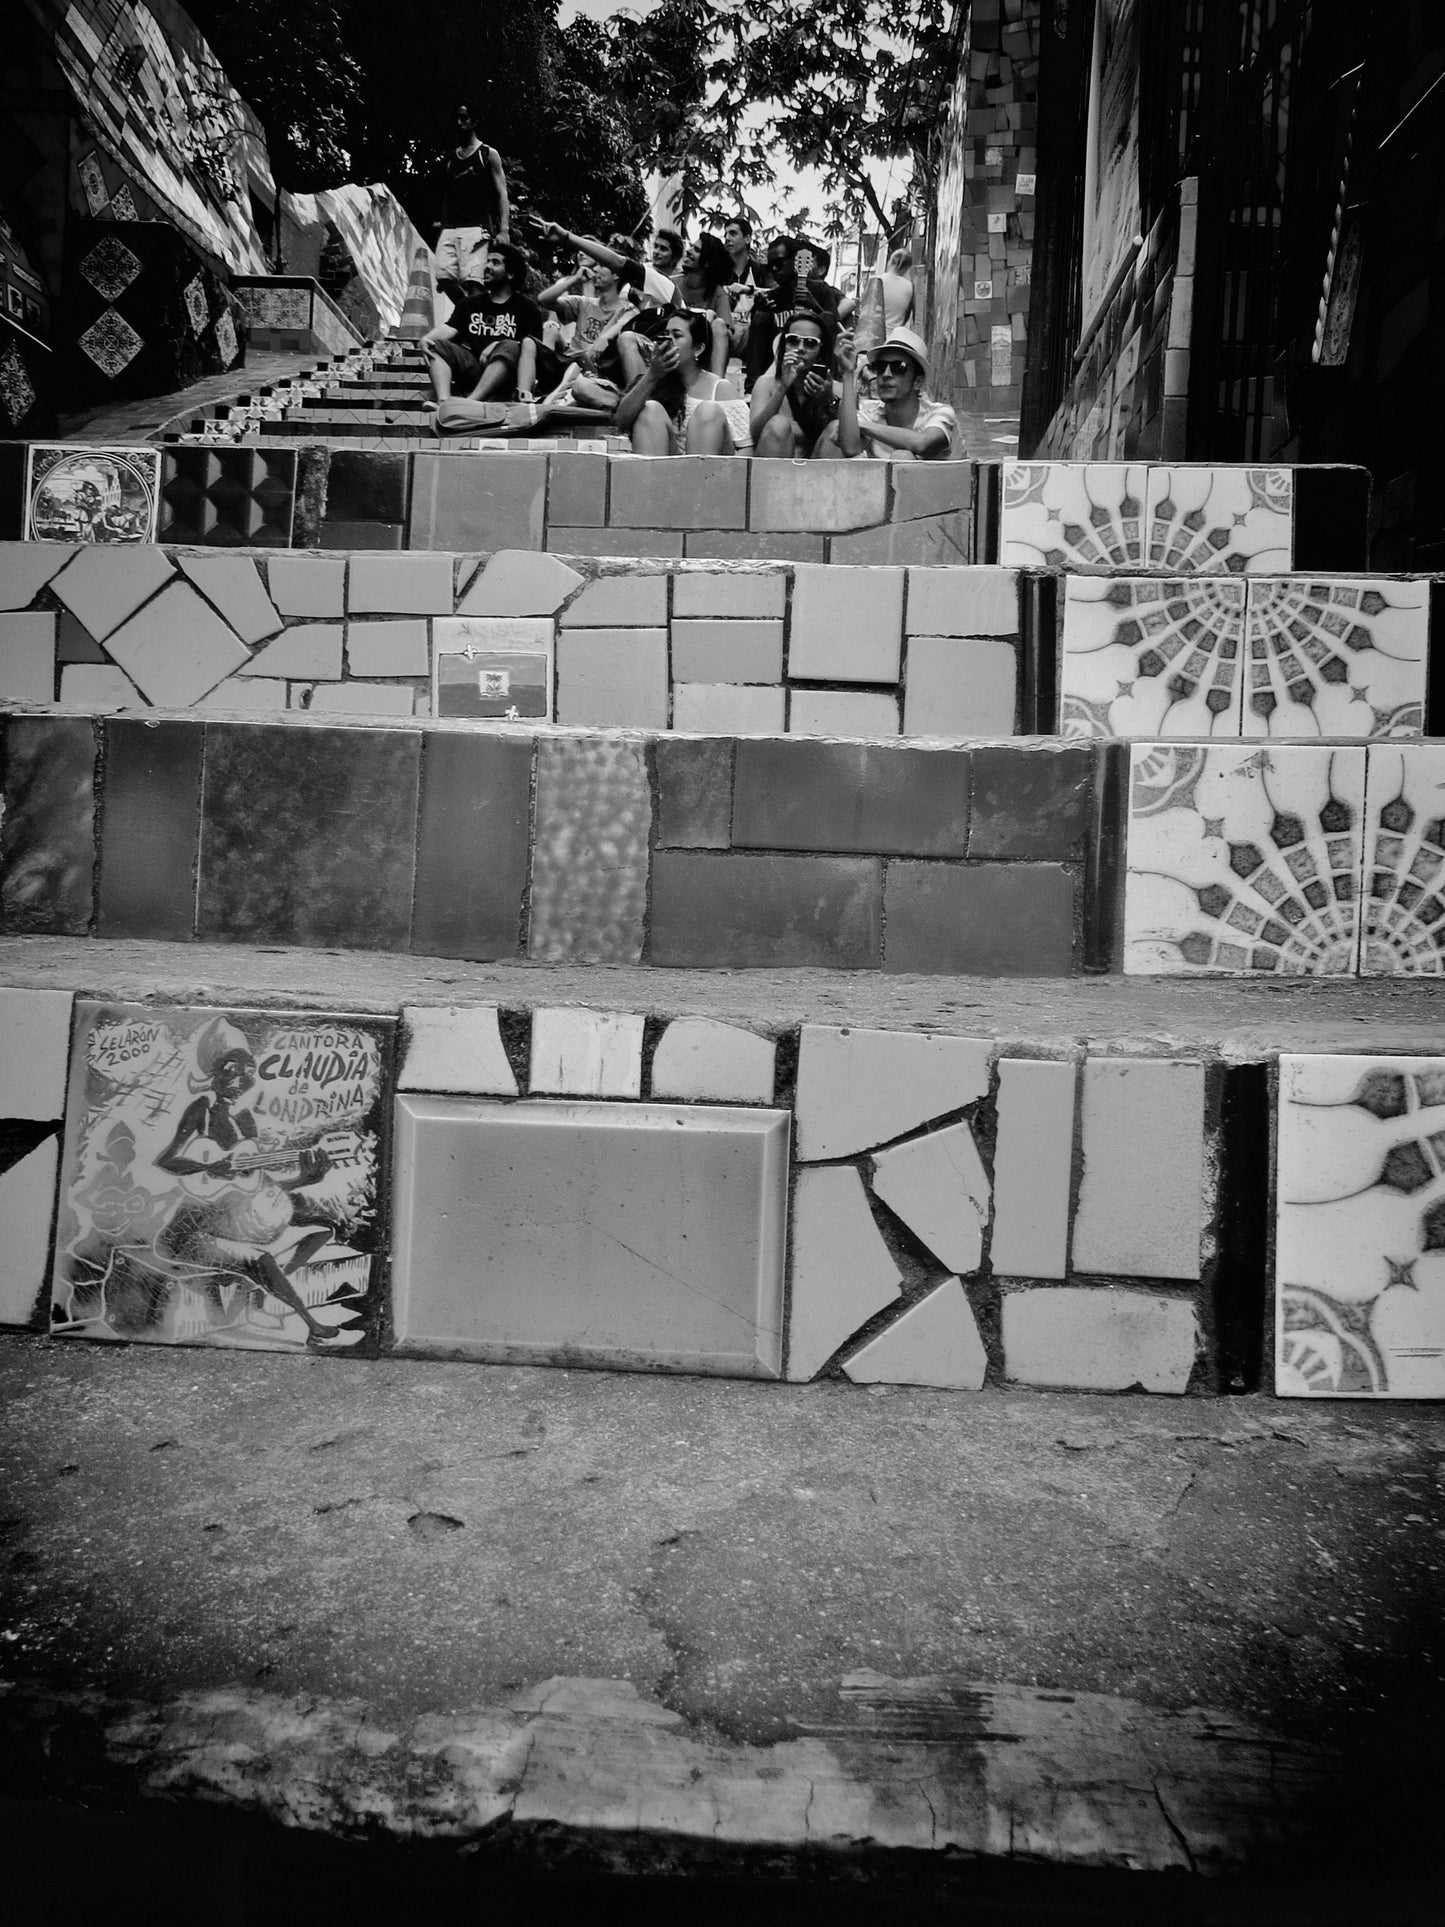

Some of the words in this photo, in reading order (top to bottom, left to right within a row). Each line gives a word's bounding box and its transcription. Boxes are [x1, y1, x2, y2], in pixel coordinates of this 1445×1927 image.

[470, 311, 517, 327] GLOBAL
[468, 323, 517, 338] CITIZEN
[274, 1033, 364, 1050] CANTORA
[106, 1043, 150, 1066] 2000
[288, 1079, 309, 1095] de
